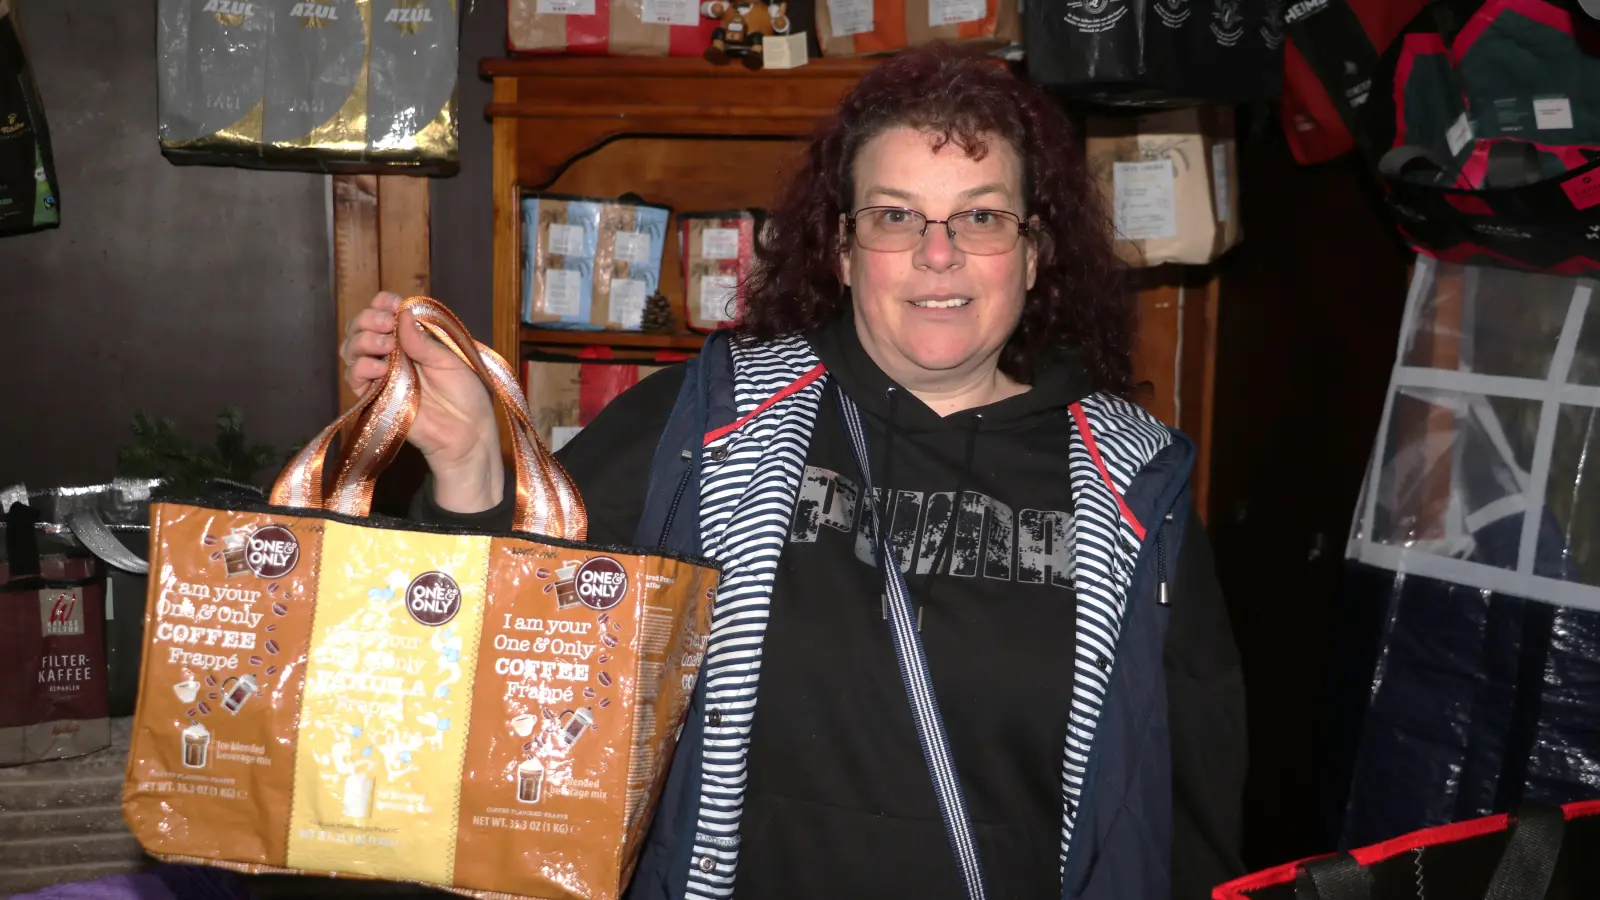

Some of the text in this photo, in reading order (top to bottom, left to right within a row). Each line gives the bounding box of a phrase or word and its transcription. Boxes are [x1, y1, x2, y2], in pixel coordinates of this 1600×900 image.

[202, 0, 255, 16] AZUL
[289, 2, 339, 20] AZUL
[384, 7, 433, 22] AZUL
[250, 552, 291, 567] ONLY
[178, 583, 210, 599] am
[212, 587, 261, 603] your
[579, 583, 619, 598] ONLY
[156, 599, 265, 628] One & Only
[411, 599, 453, 614] ONLY
[503, 614, 592, 635] I am your
[156, 623, 257, 650] COFFEE
[494, 635, 597, 660] One & Only
[42, 654, 91, 668] FILTER-
[168, 647, 239, 671] Frappé
[38, 667, 92, 683] KAFFEE
[495, 658, 590, 682] COFFEE
[506, 681, 574, 704] Frappé
[216, 740, 266, 754] Ice blended
[216, 751, 272, 766] beverage mix
[138, 781, 155, 792] NET
[157, 781, 175, 792] WT.
[177, 783, 195, 794] 35.3
[196, 785, 209, 795] OZ
[565, 777, 600, 788] blended
[550, 786, 608, 800] berage mix
[472, 816, 490, 826] NET
[491, 817, 508, 828] WT.
[509, 819, 528, 830] 35.3
[529, 821, 542, 831] OZ
[553, 824, 569, 835] KG)
